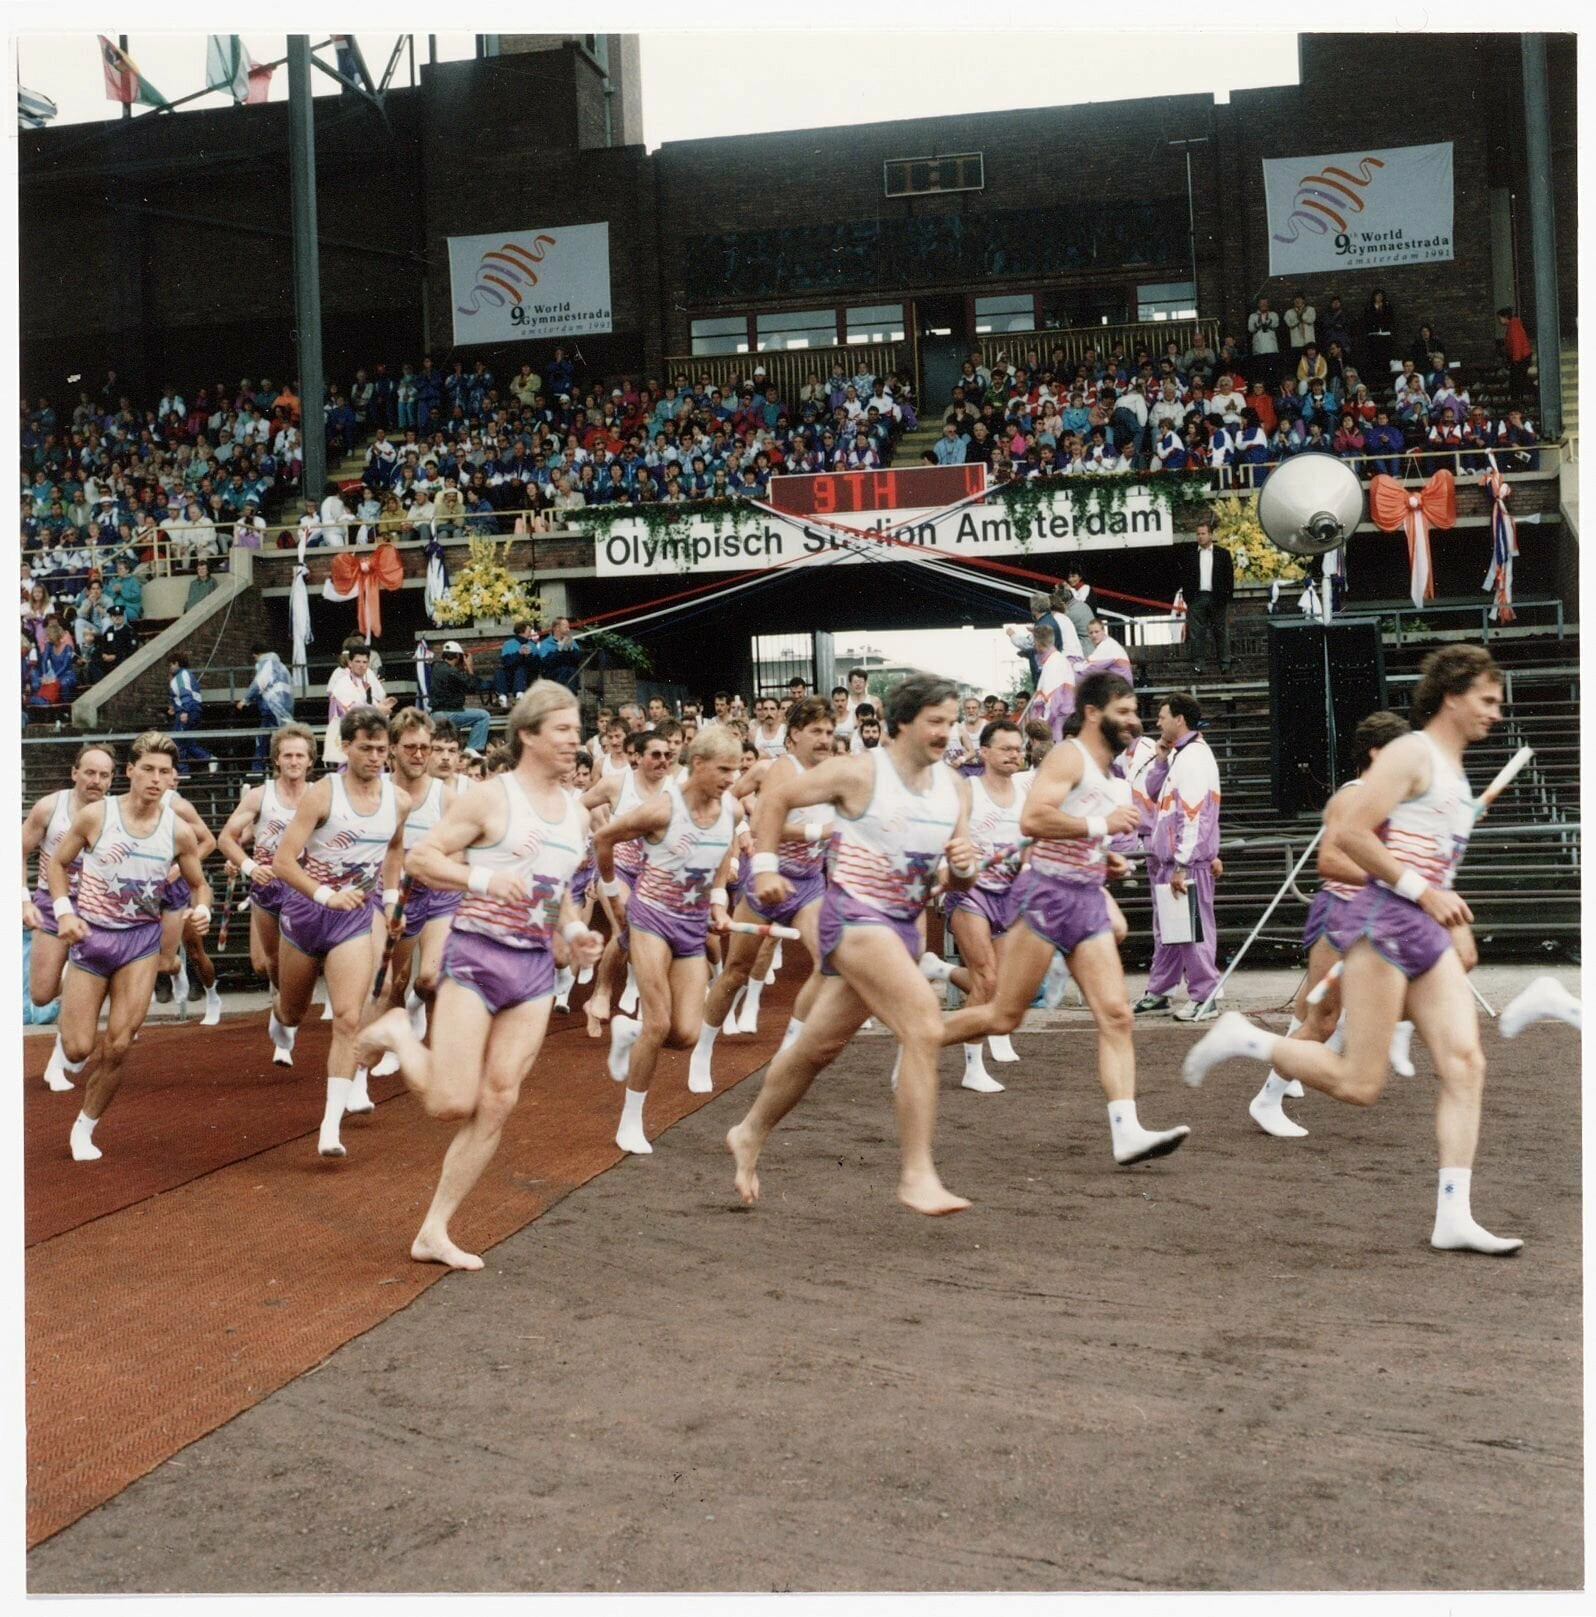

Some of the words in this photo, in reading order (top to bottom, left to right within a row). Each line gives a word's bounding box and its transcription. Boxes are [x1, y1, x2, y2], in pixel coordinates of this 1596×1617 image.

[1361, 229, 1402, 242] World
[1348, 236, 1449, 255] Gymnaestrada
[1347, 254, 1419, 265] amsterdam
[1425, 249, 1450, 259] 1991
[535, 302, 570, 314] World
[522, 308, 610, 327] Gymnaestrada
[589, 322, 610, 330] 1991
[813, 473, 896, 513] 9TH
[605, 525, 783, 568] Olympisch
